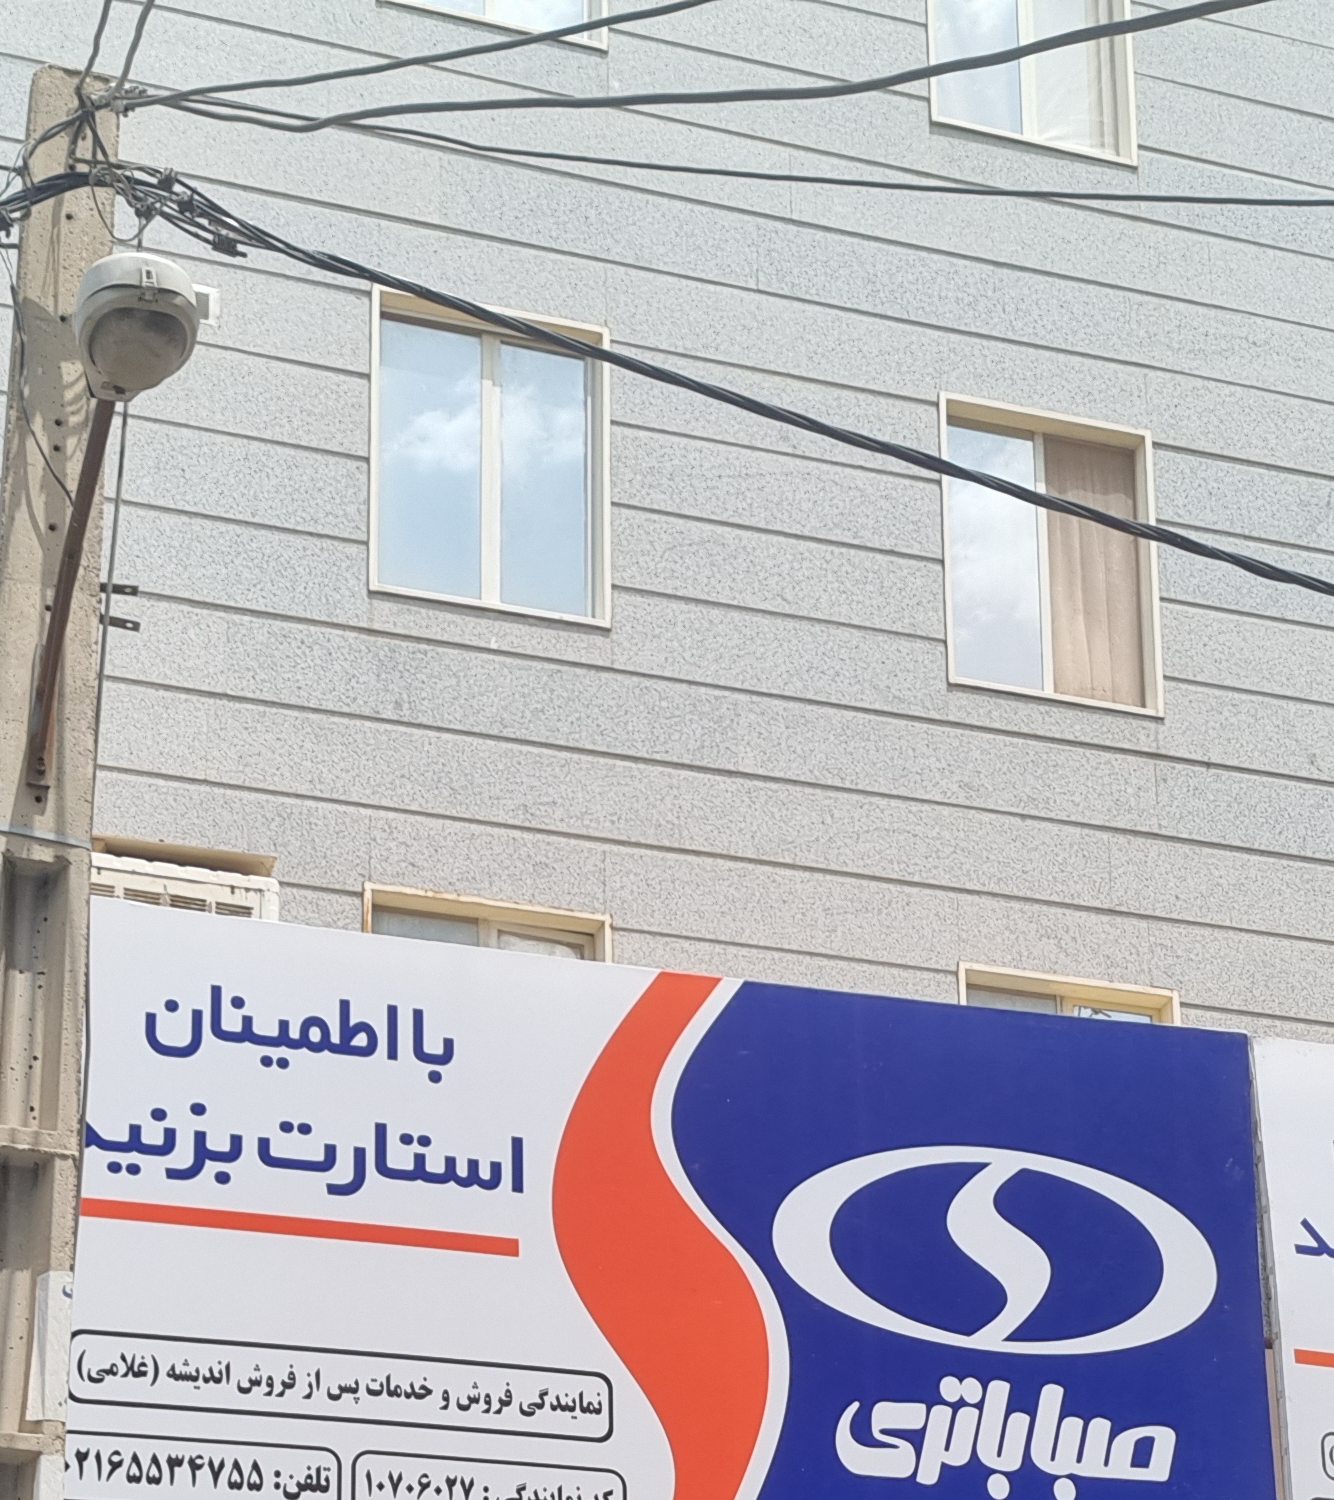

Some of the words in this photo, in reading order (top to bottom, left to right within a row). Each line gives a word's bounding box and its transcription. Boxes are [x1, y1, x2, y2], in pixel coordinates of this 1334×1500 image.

[144, 984, 401, 1070] اطمینان
[412, 1008, 455, 1084] با
[257, 1121, 525, 1196] استارت
[76, 1348, 161, 1387] (غلامی)
[166, 1359, 231, 1390] اندیشه
[236, 1361, 297, 1399] فروش
[302, 1366, 321, 1401] از
[327, 1374, 360, 1406] پس
[366, 1374, 434, 1402] خدمات
[439, 1390, 450, 1411] و
[456, 1381, 514, 1415] فروش
[519, 1387, 604, 1421] نمایندگی
